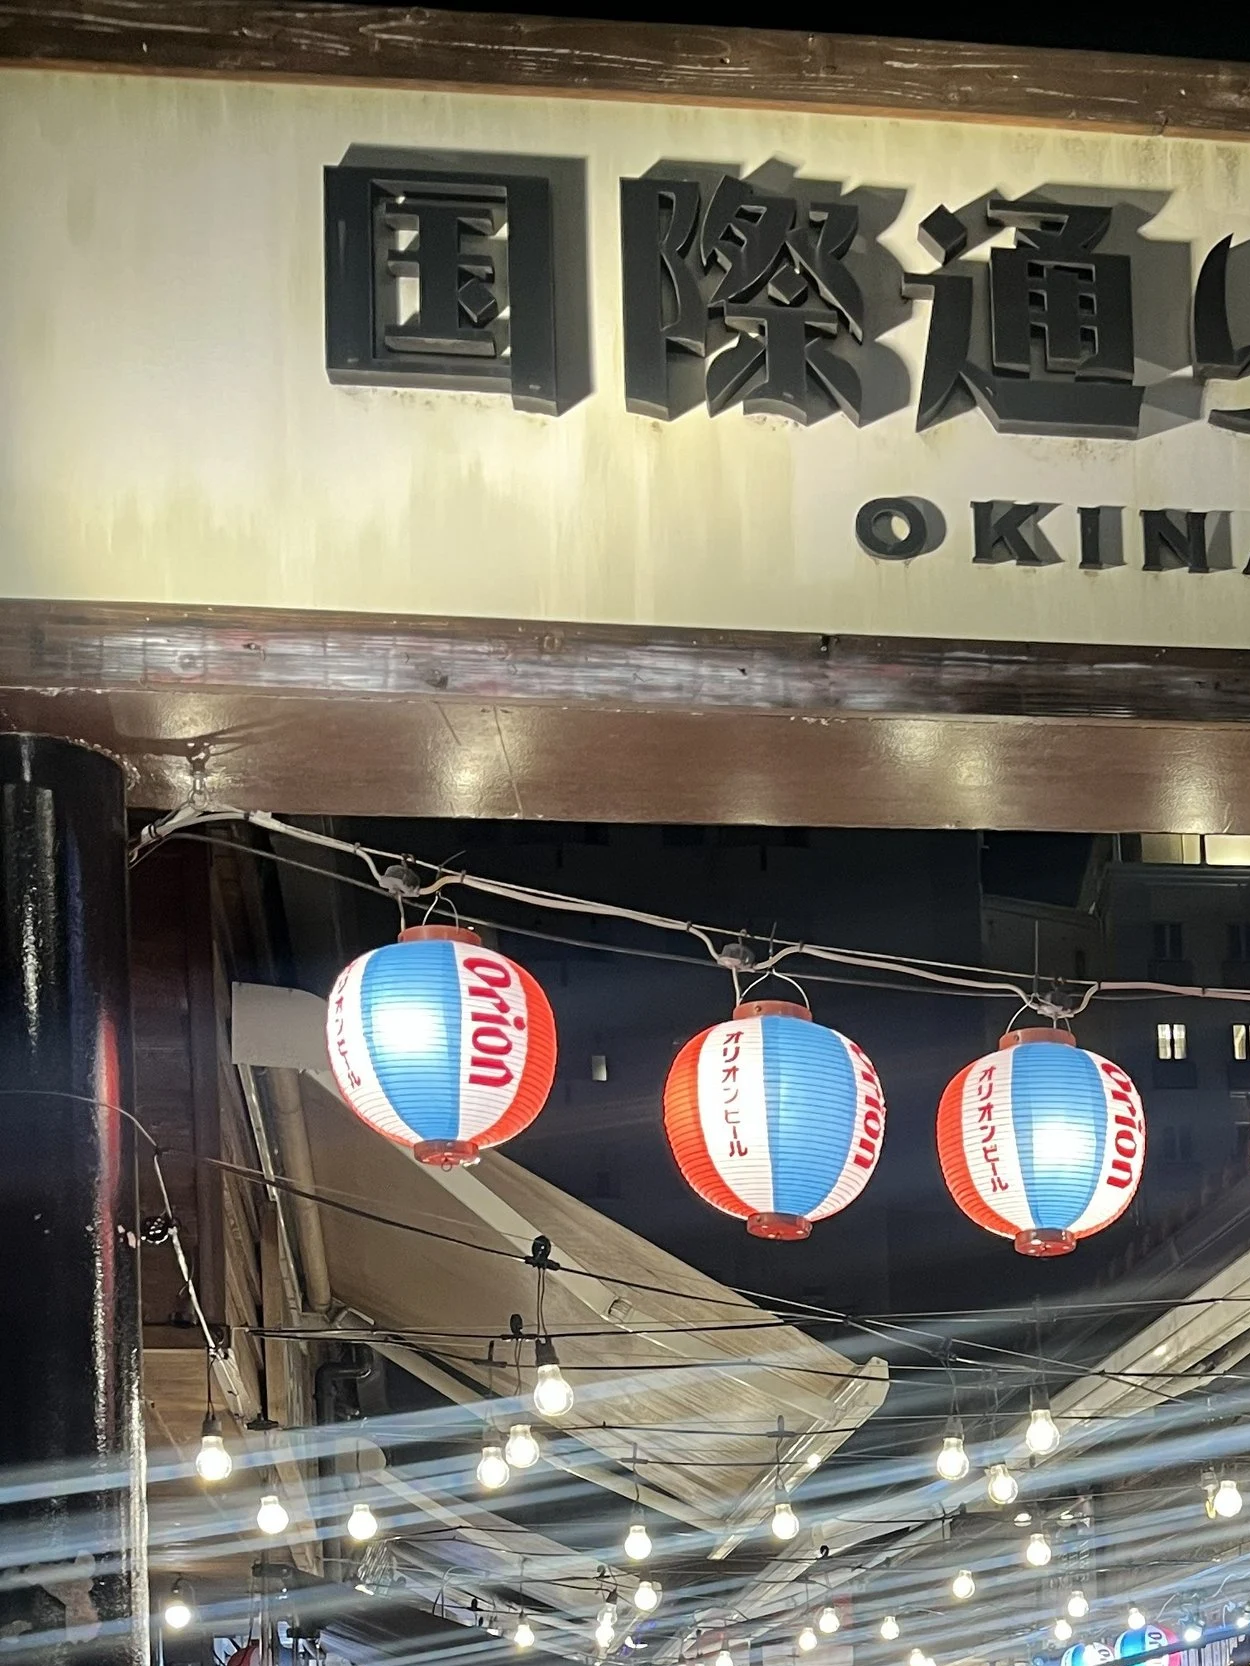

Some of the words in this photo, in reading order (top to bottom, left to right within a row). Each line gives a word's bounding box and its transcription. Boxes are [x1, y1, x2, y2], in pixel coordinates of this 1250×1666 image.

[977, 1065, 1009, 1193] オリオンビール
